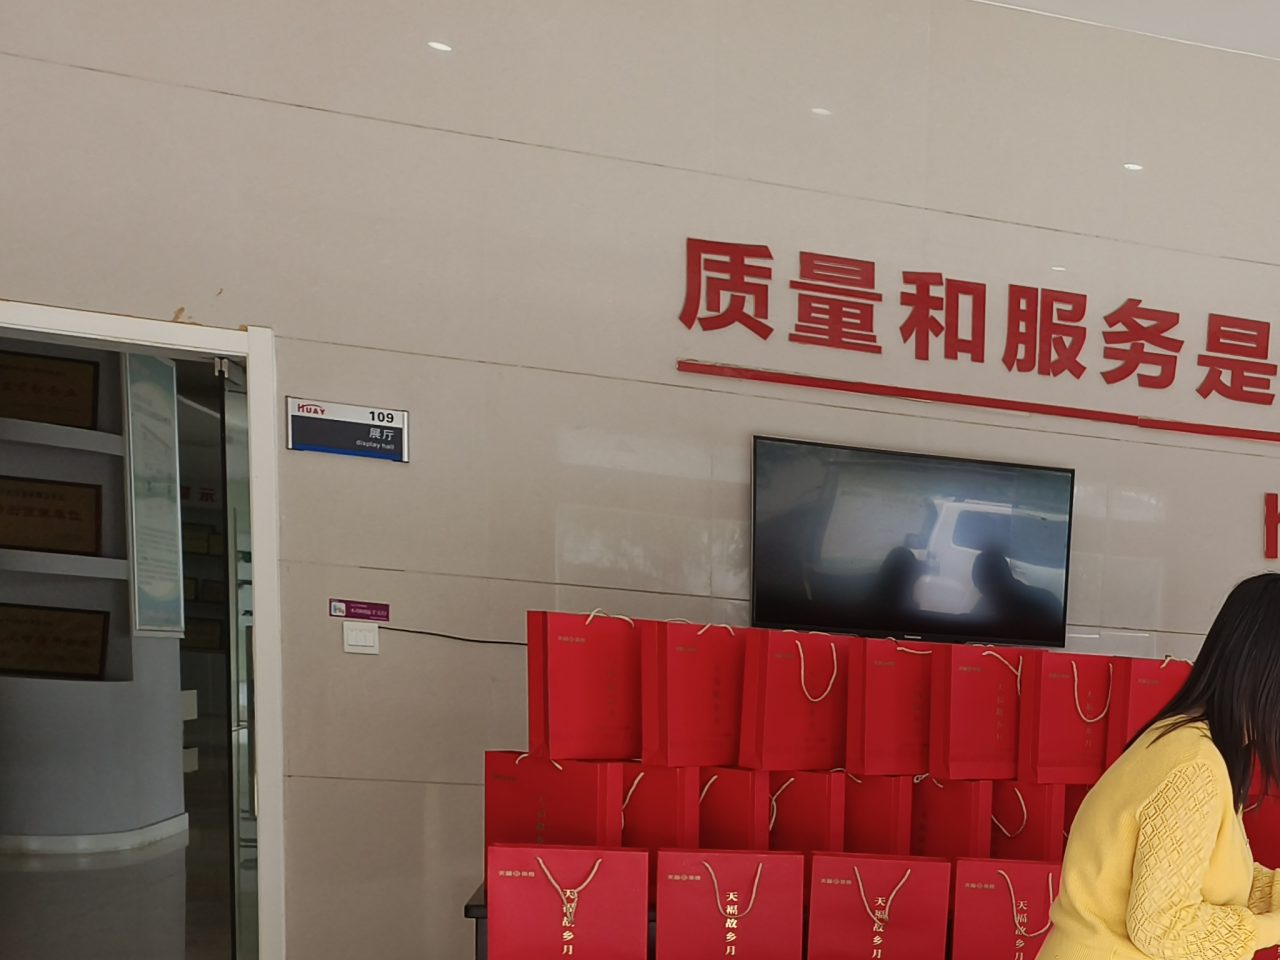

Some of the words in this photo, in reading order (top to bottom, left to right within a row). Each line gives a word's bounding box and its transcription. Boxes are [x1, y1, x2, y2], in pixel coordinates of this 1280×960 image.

[297, 403, 325, 415] HUAY
[369, 411, 394, 423] 109
[369, 427, 394, 441] 展厅
[725, 891, 738, 956] 天福故乡月
